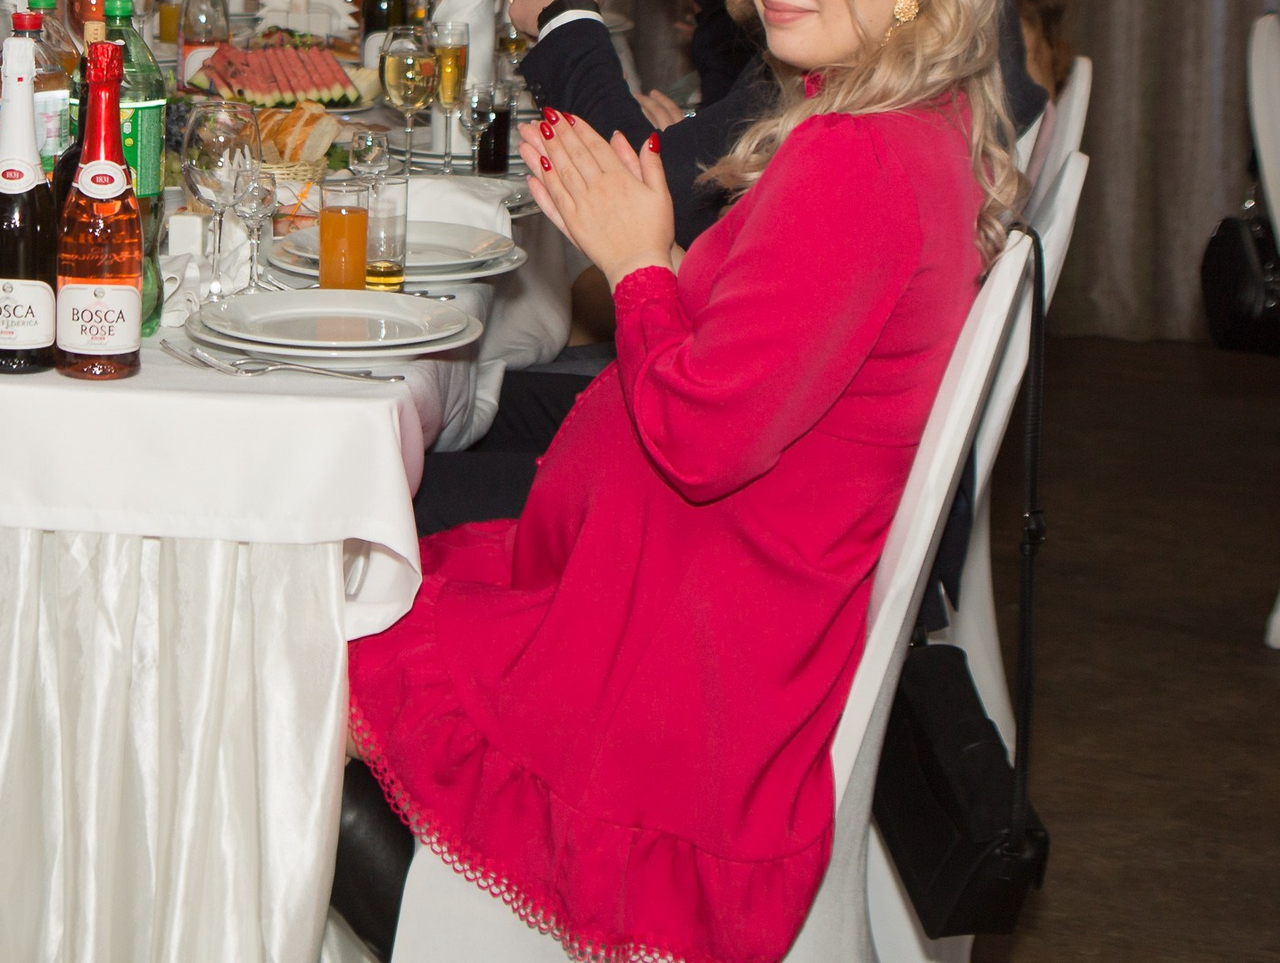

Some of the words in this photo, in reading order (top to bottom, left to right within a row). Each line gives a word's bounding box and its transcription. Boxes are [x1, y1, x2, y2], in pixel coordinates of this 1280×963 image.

[6, 170, 19, 179] 1831
[96, 174, 109, 184] 1831
[72, 307, 126, 324] BOSCA
[80, 324, 115, 337] ROSE
